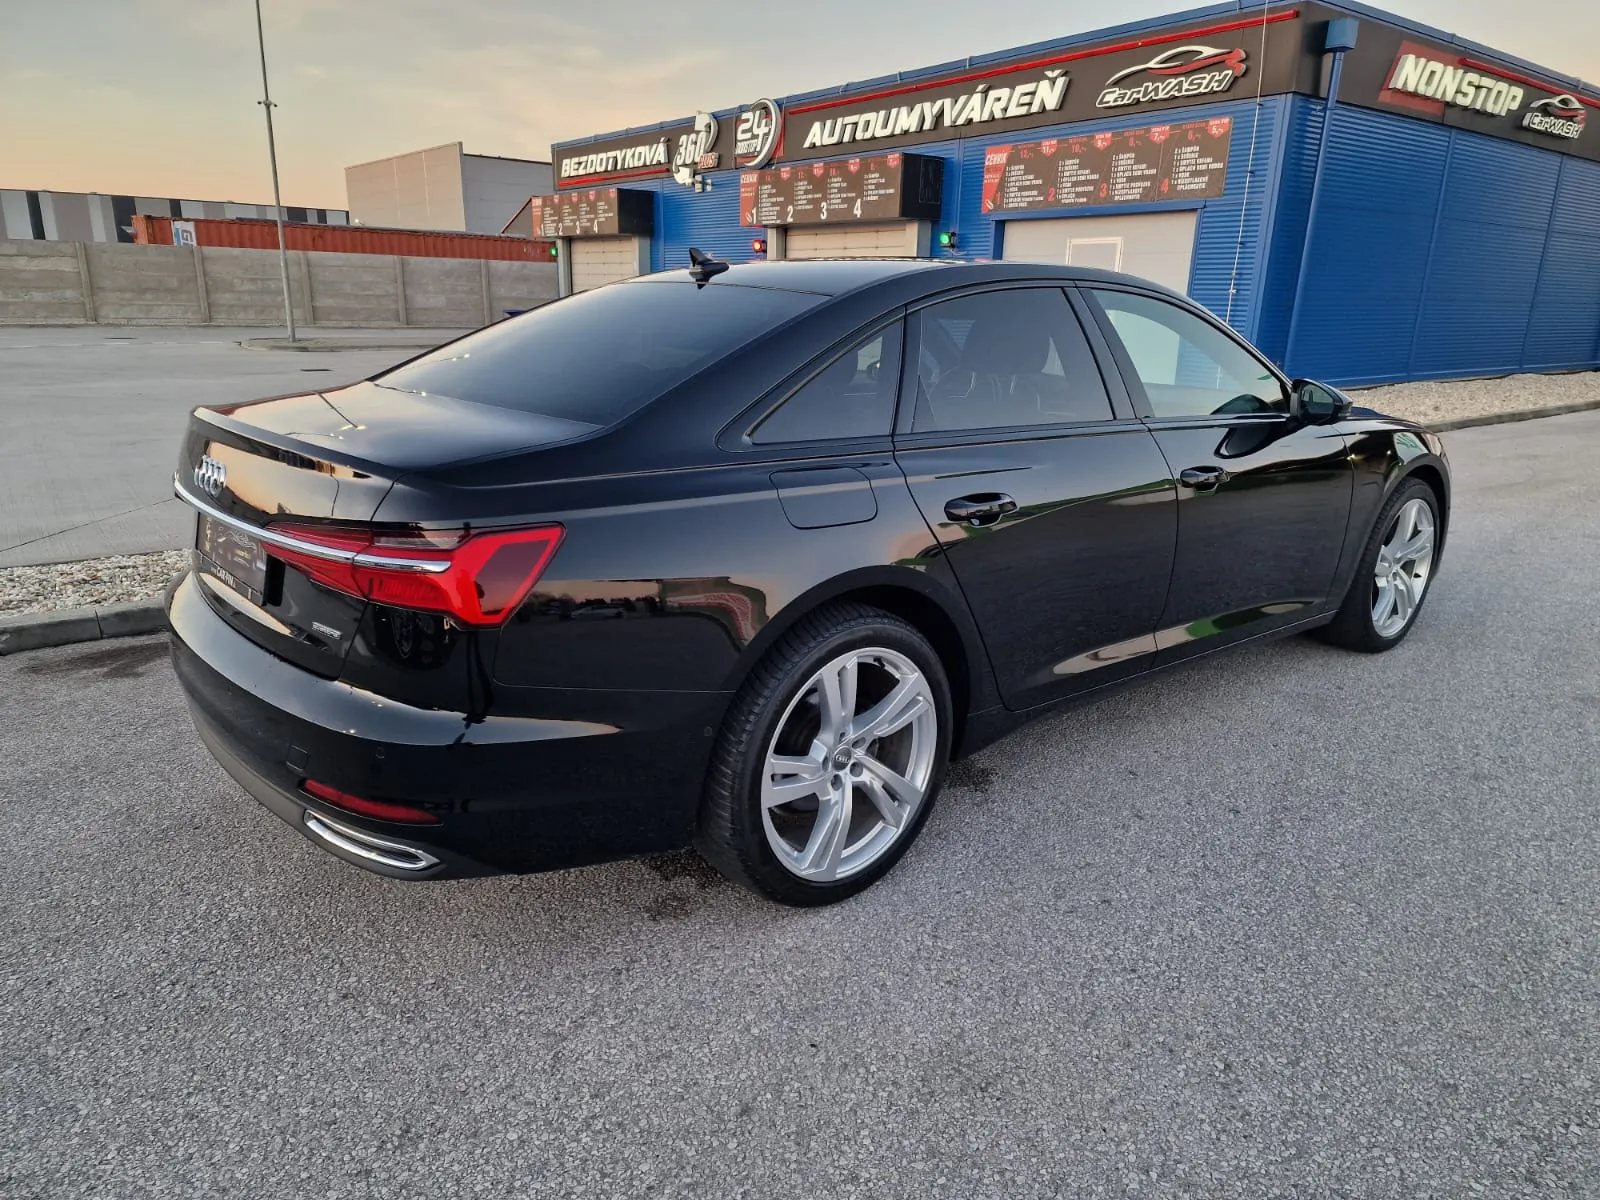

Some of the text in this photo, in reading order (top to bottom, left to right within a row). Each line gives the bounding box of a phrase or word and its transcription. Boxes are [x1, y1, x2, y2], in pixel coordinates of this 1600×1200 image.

[1388, 54, 1524, 116] NONSTOP
[802, 70, 1070, 149] AUTOUMYVÁREŇ
[737, 110, 771, 151] 24
[561, 137, 669, 178] BEZDOTYKOVÁ
[677, 131, 708, 166] 360
[853, 198, 861, 218] 4
[1048, 188, 1056, 201] 2
[752, 207, 756, 224] 1
[787, 205, 793, 222] 2
[820, 202, 827, 219] 3
